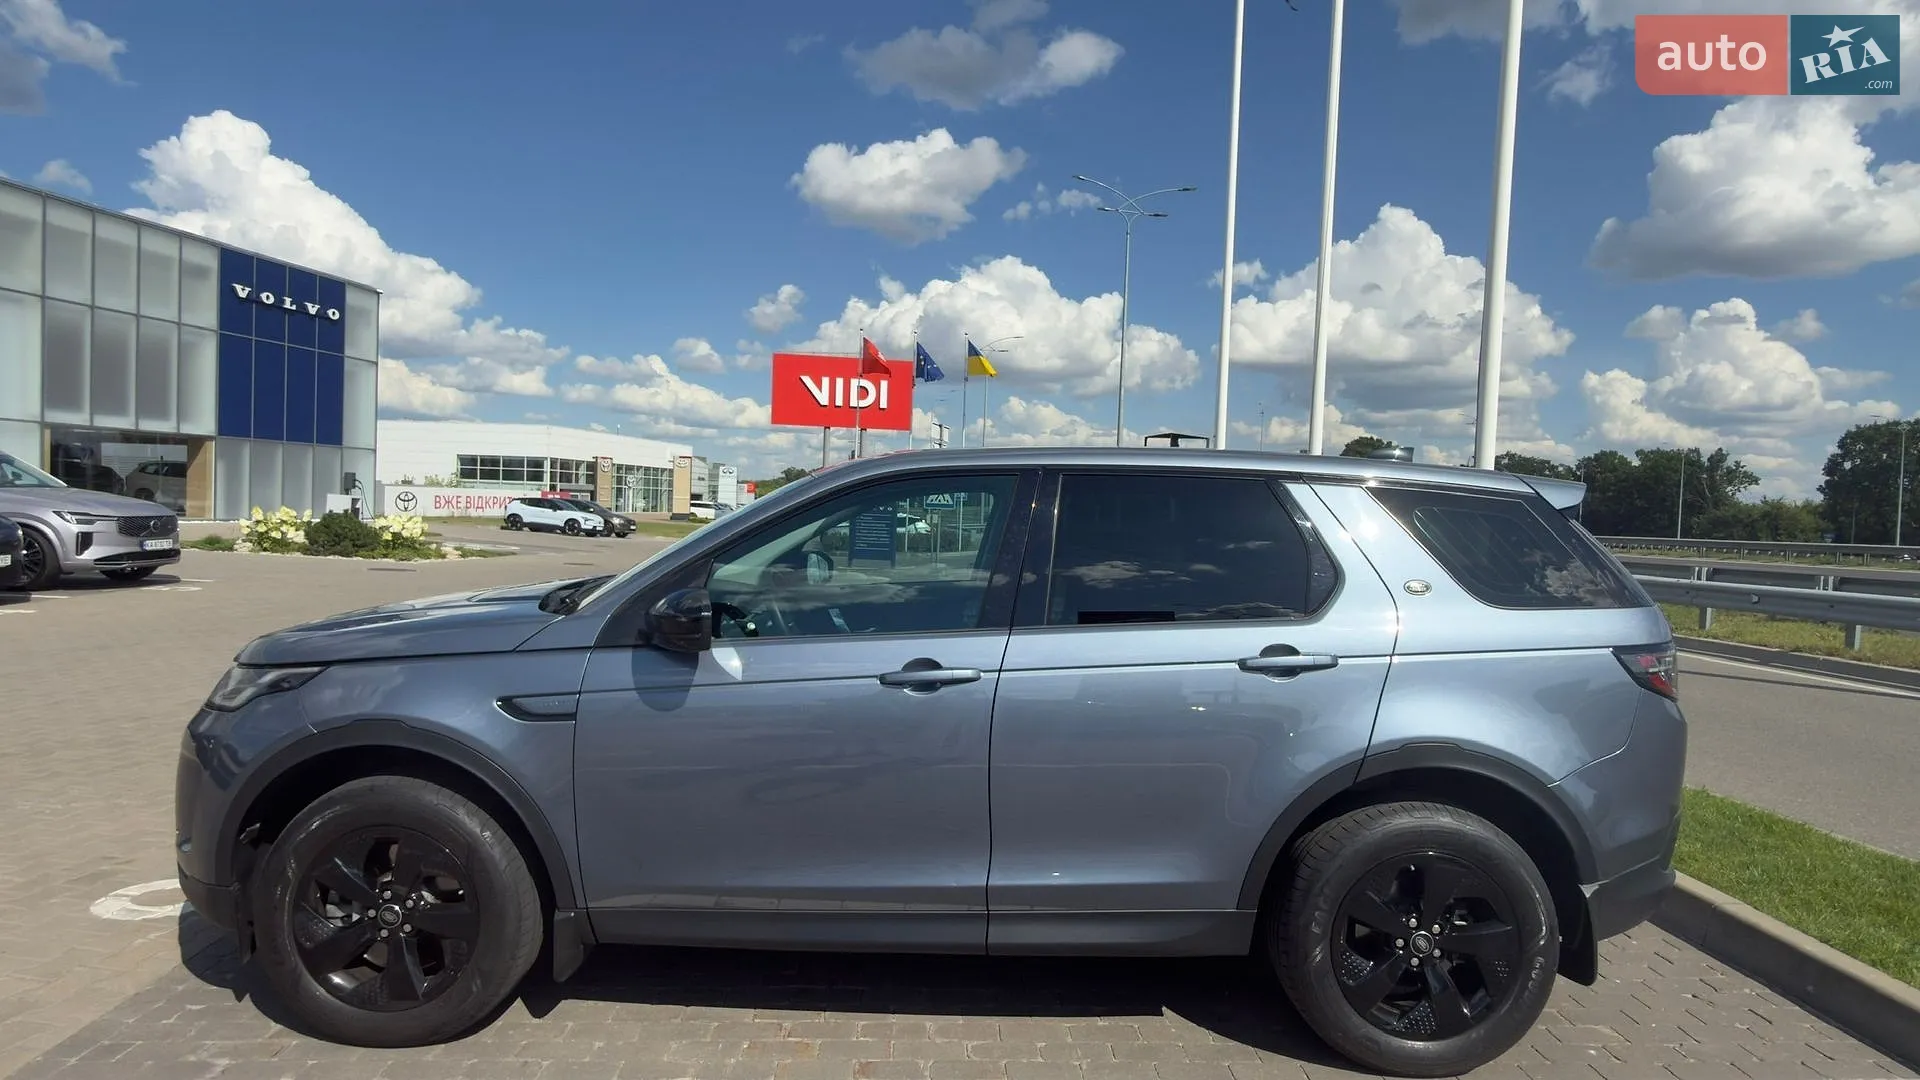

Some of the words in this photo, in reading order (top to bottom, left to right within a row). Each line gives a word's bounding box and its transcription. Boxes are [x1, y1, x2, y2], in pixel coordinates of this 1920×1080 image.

[232, 283, 340, 320] VOLVO
[799, 375, 889, 409] VIDI
[434, 495, 462, 509] ВЖЕ
